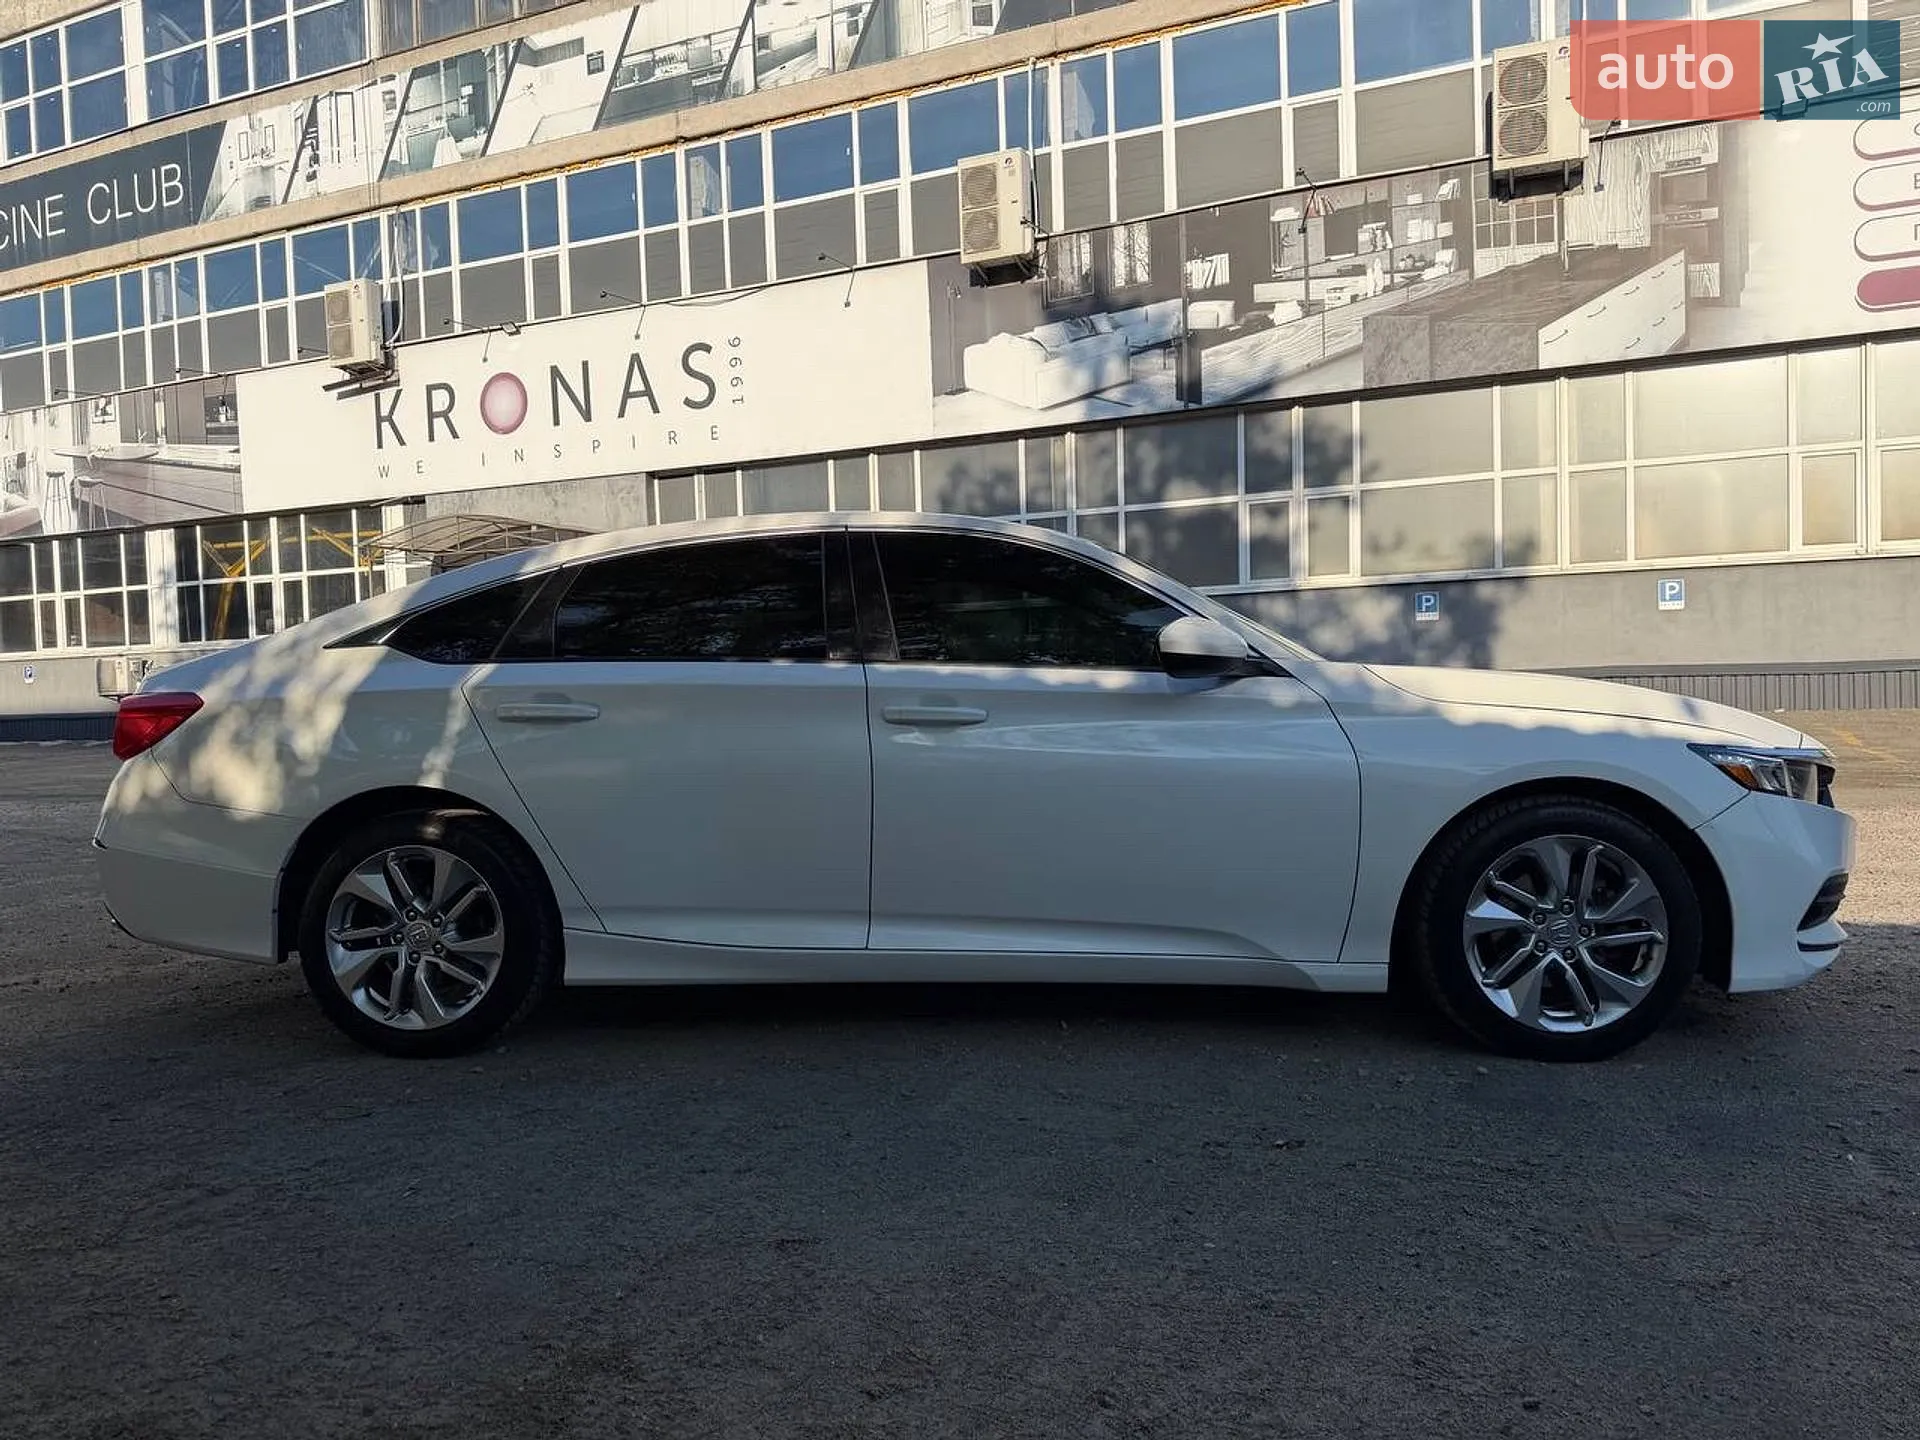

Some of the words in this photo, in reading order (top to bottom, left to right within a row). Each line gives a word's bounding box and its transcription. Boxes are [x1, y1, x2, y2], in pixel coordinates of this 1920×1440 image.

[87, 163, 184, 225] CLUB
[374, 341, 717, 450] KRONAS
[727, 335, 745, 405] 1996
[378, 459, 425, 479] WE
[480, 425, 720, 467] INSPIRE
[1421, 594, 1435, 612] P
[1665, 582, 1679, 601] P
